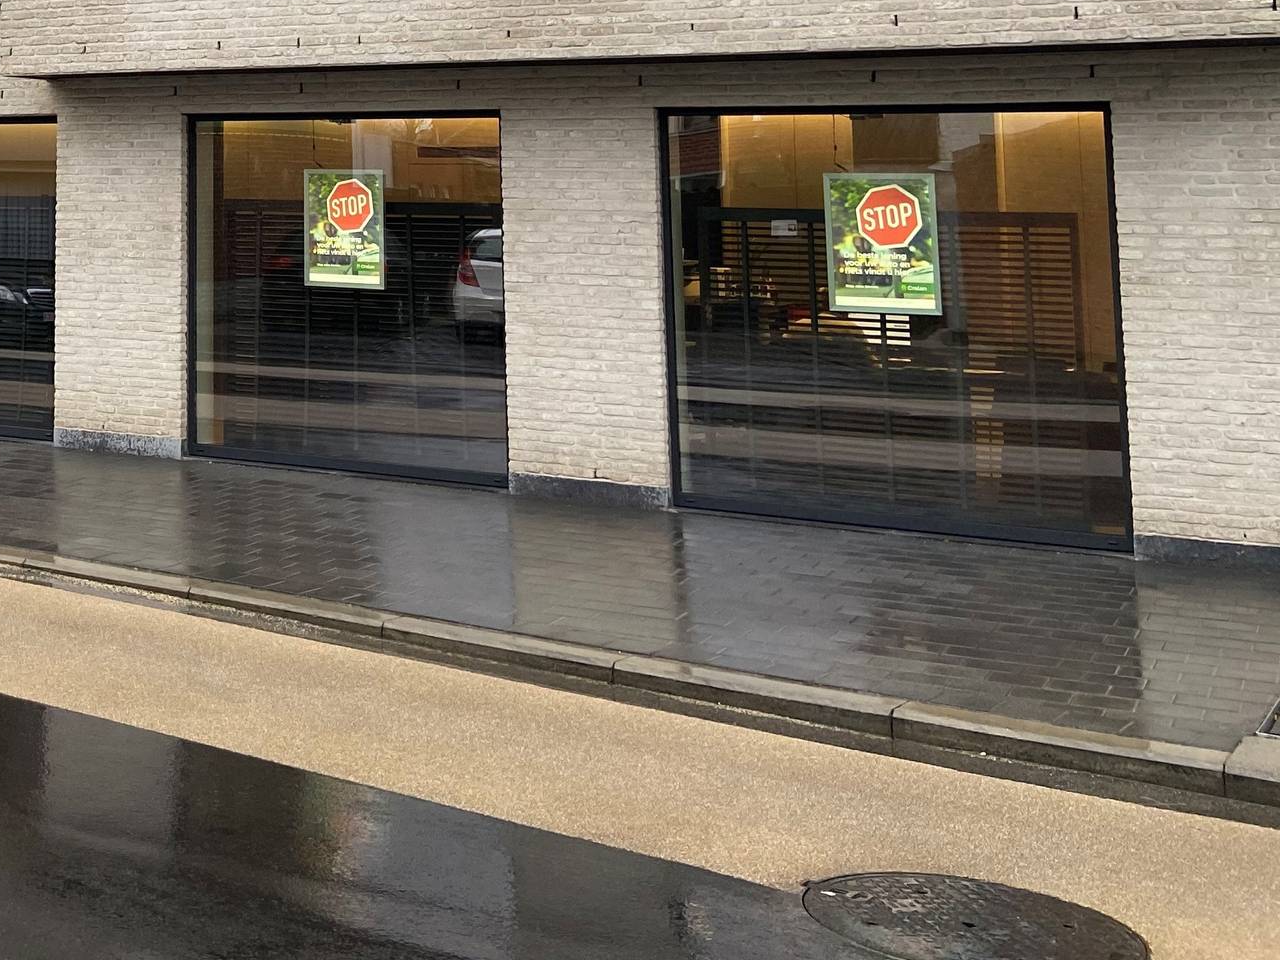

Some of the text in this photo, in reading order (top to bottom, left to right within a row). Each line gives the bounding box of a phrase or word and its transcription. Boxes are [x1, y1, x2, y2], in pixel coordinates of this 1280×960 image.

[331, 194, 367, 218] STOP
[862, 202, 912, 232] STOP
[881, 252, 907, 261] lning
